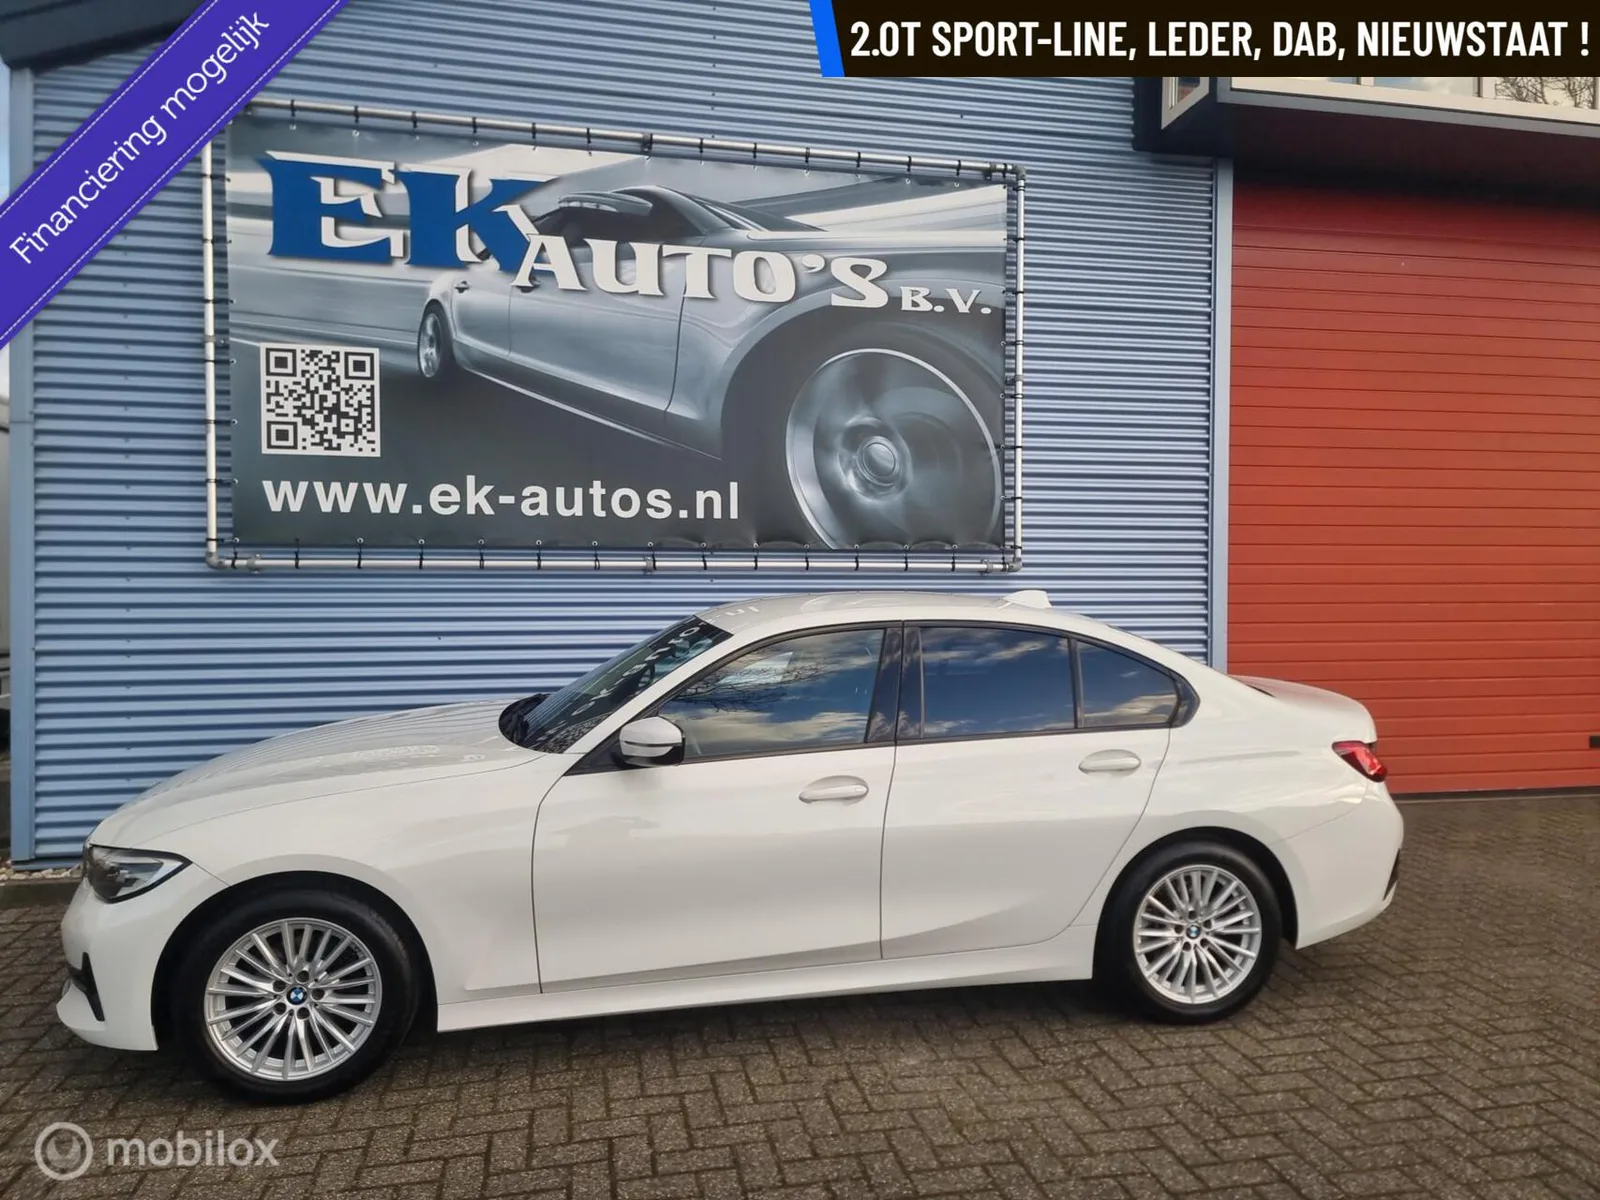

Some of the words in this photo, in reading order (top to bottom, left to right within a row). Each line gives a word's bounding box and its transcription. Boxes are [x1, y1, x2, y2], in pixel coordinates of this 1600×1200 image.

[260, 150, 556, 273] EK
[900, 285, 992, 315] B.V.
[261, 474, 739, 520] www.ek-autos.nl
